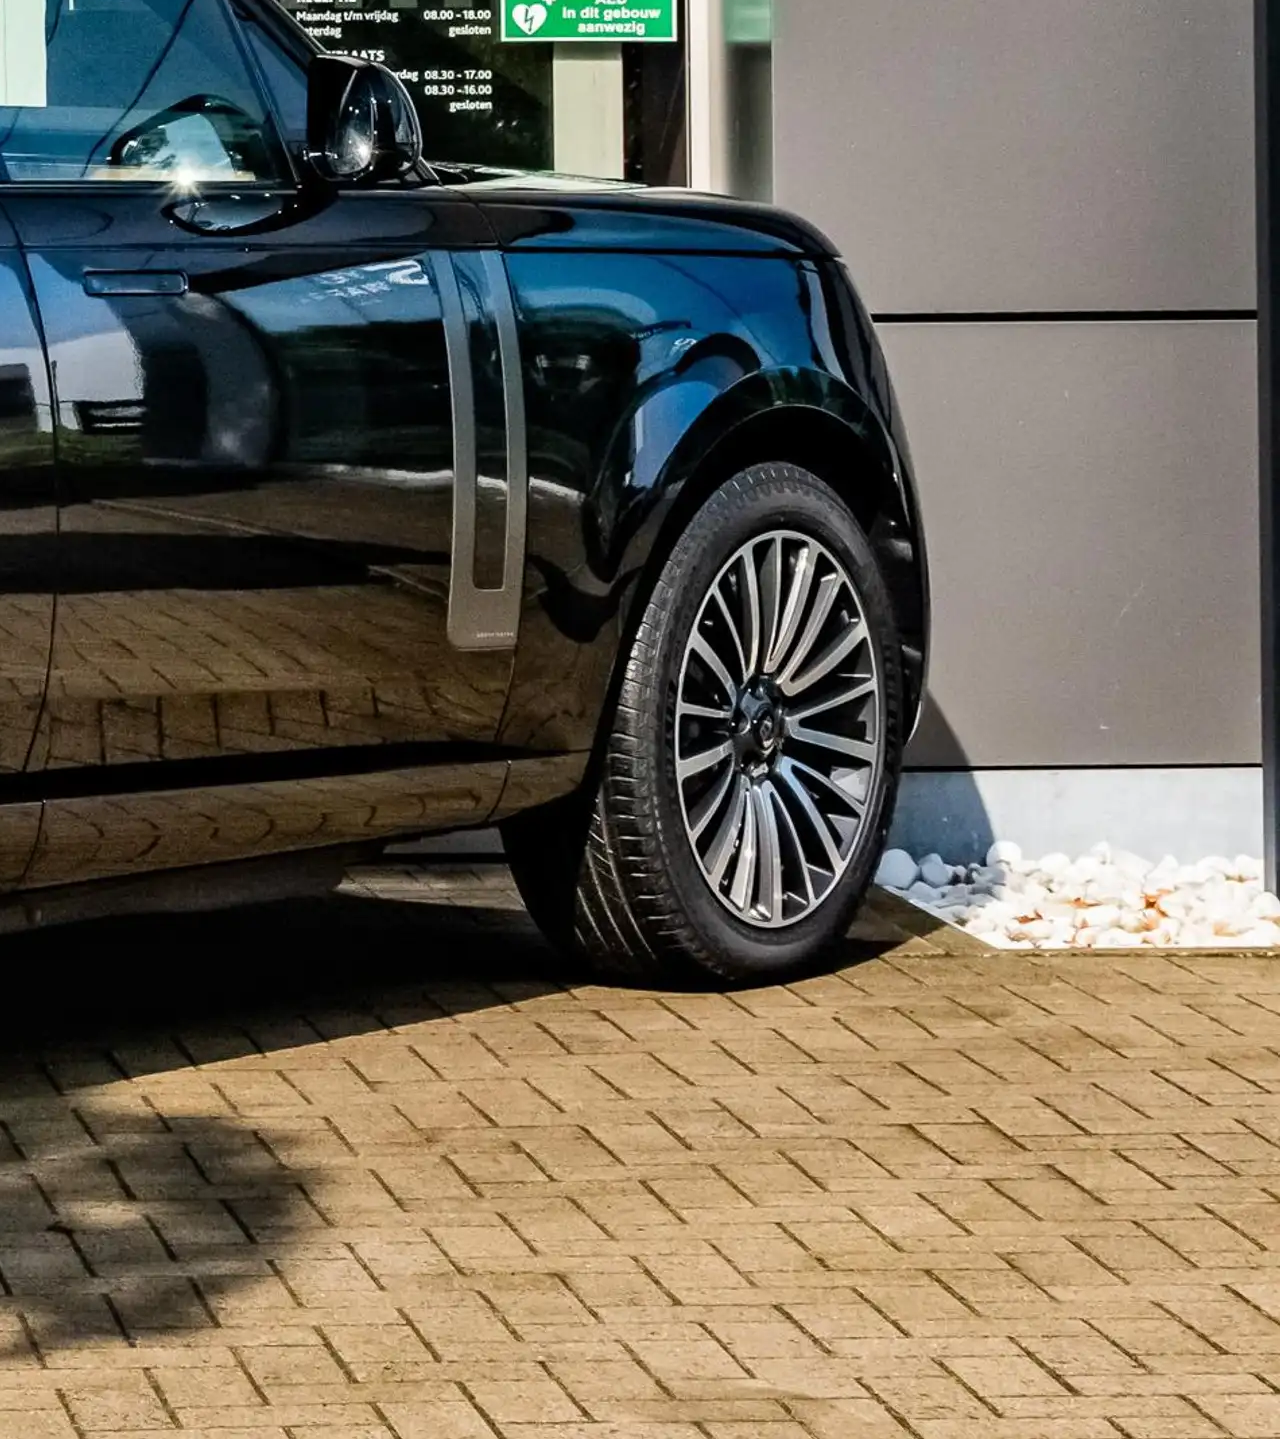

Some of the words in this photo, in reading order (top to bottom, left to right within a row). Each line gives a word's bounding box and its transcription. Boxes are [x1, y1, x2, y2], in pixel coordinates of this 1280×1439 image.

[296, 11, 342, 23] Maandag
[344, 11, 363, 21] t/m
[365, 11, 399, 23] vrijdag
[423, 10, 453, 21] 08.00
[464, 10, 491, 21] 18.00
[562, 7, 576, 19] in
[580, 7, 599, 19] dit
[603, 8, 661, 22] gebouw
[449, 26, 491, 37] gesloten
[577, 21, 645, 35] aanwezig
[424, 70, 454, 80] 08.30
[464, 70, 492, 80] 17.00
[424, 85, 454, 95] 08.30
[464, 85, 492, 95] 16.00
[450, 100, 492, 112] gesloten
